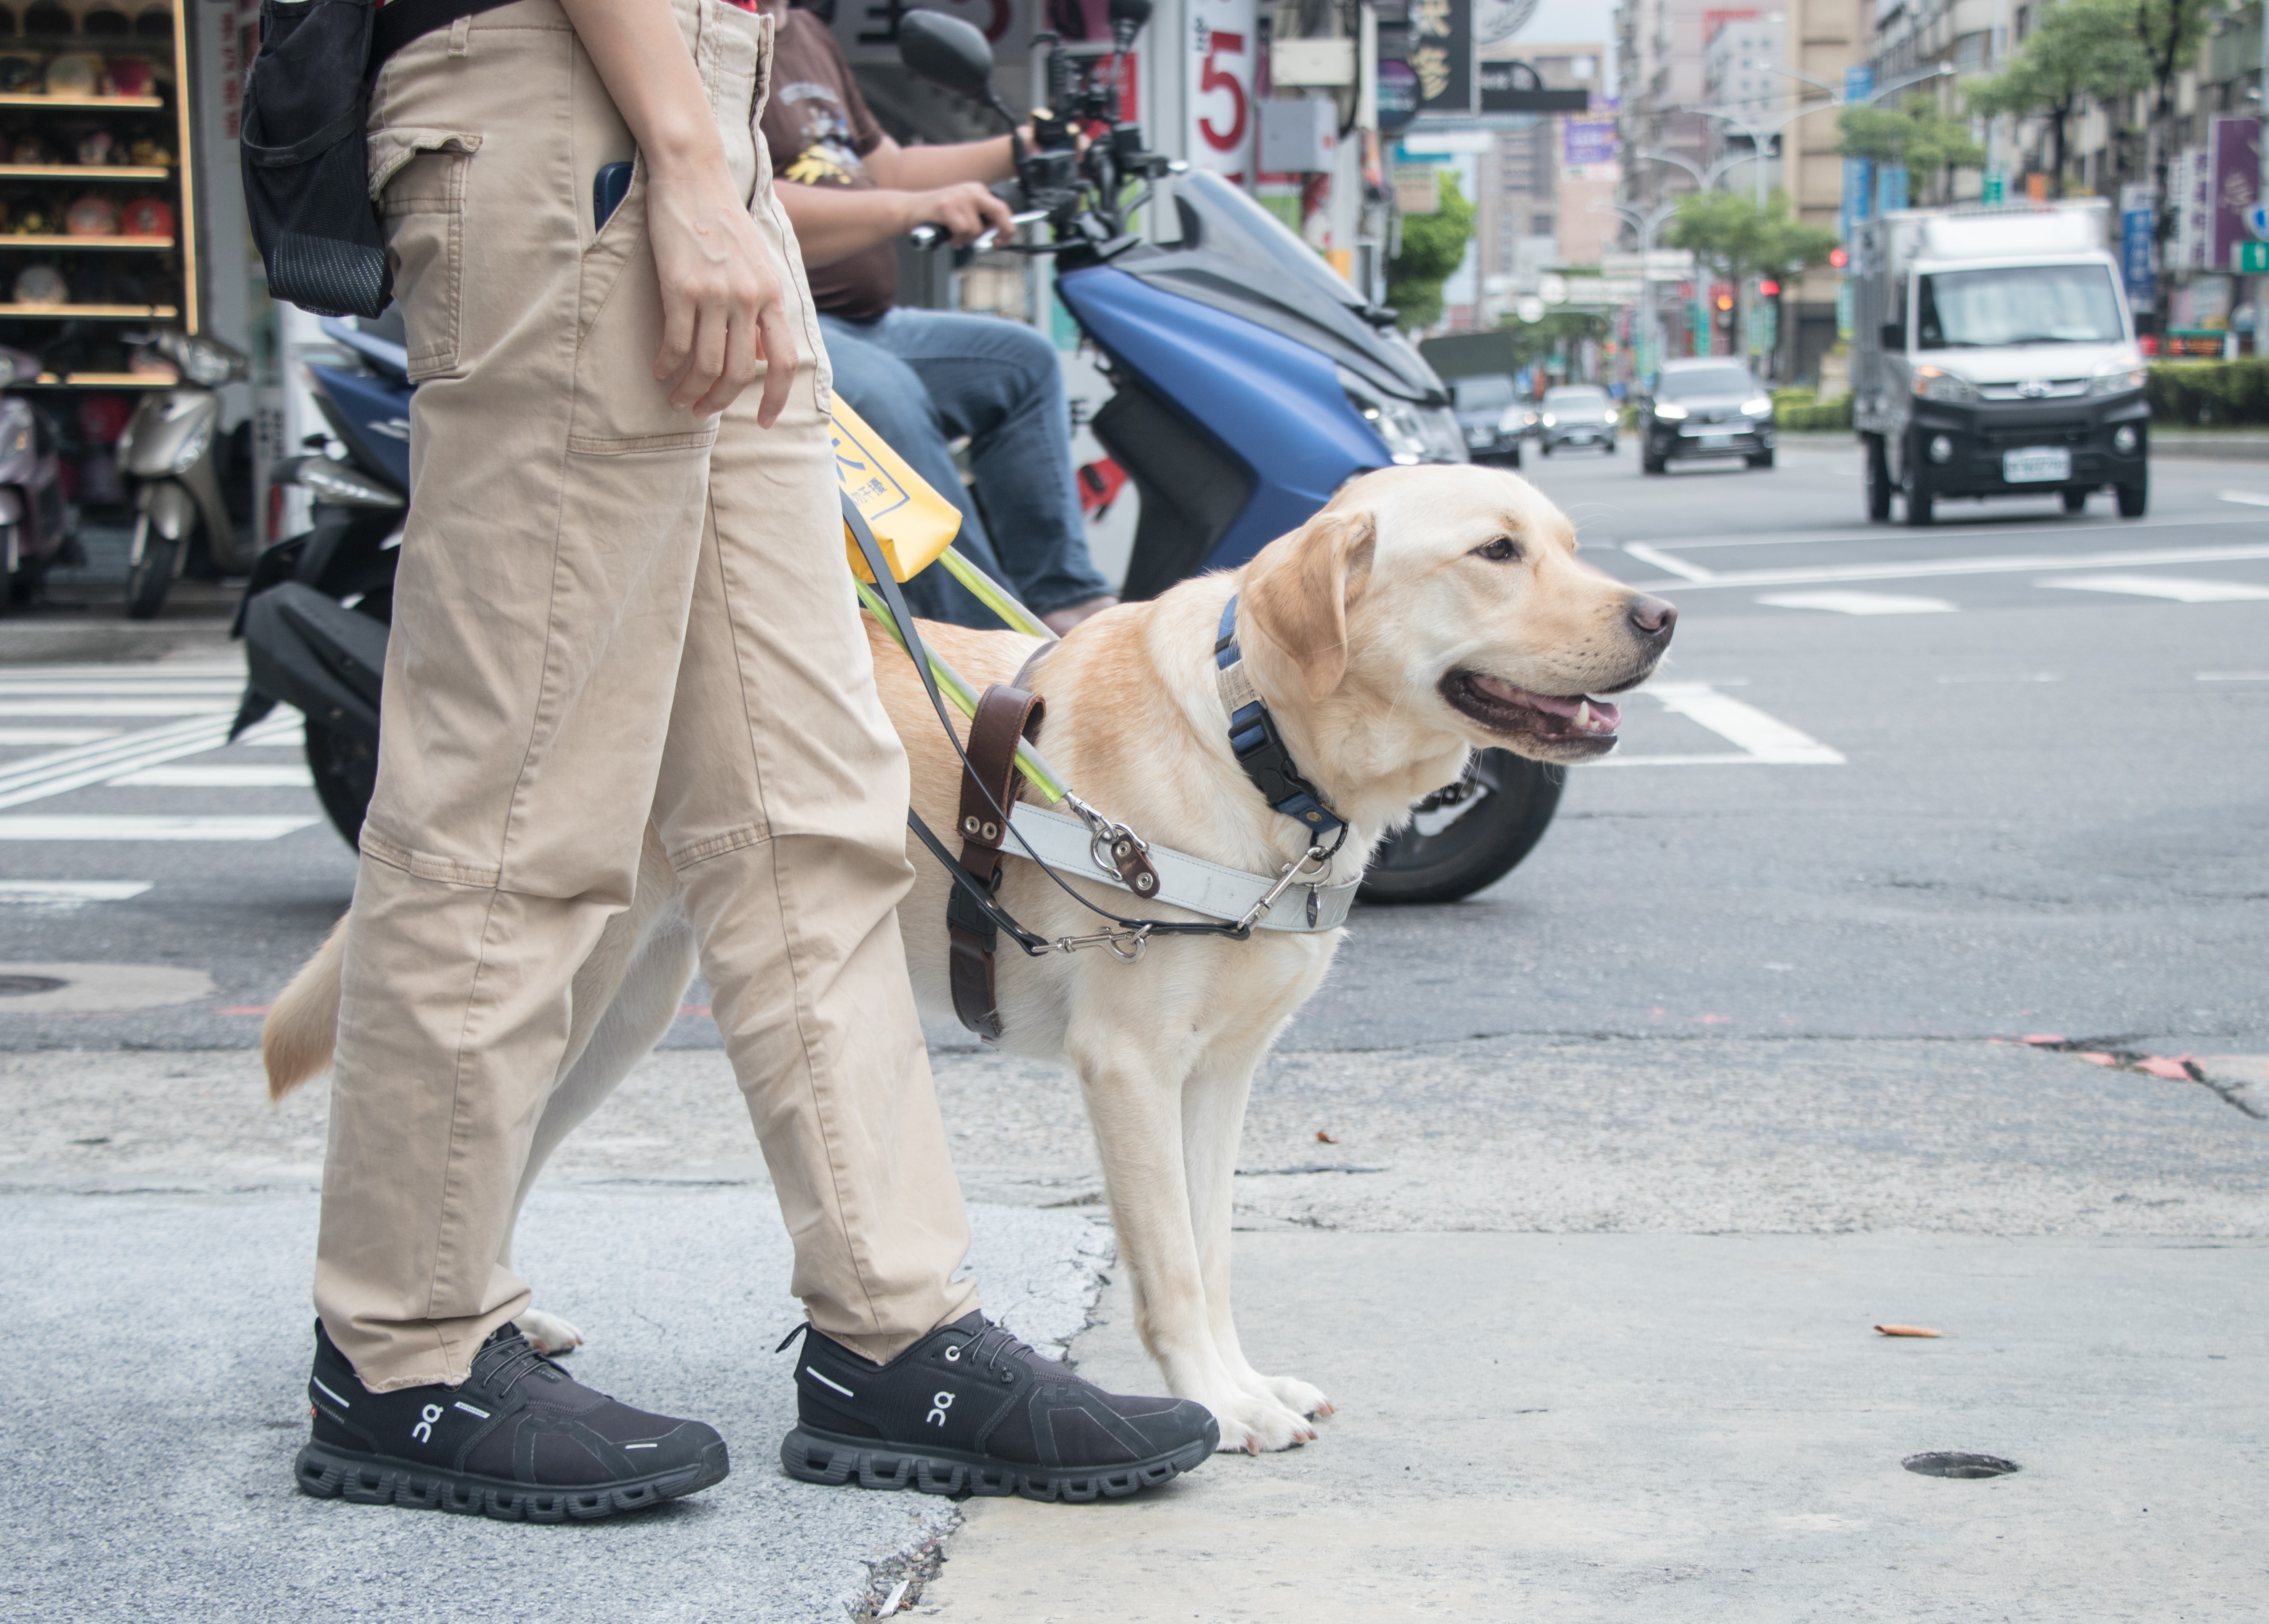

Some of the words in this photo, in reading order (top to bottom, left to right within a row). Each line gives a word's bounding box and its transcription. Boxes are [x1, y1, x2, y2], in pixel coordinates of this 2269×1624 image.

[1199, 31, 1245, 152] 5
[849, 477, 888, 507] 勿干擾
[1231, 670, 1244, 700] Quest
[459, 1404, 485, 1416] WATERPROOF
